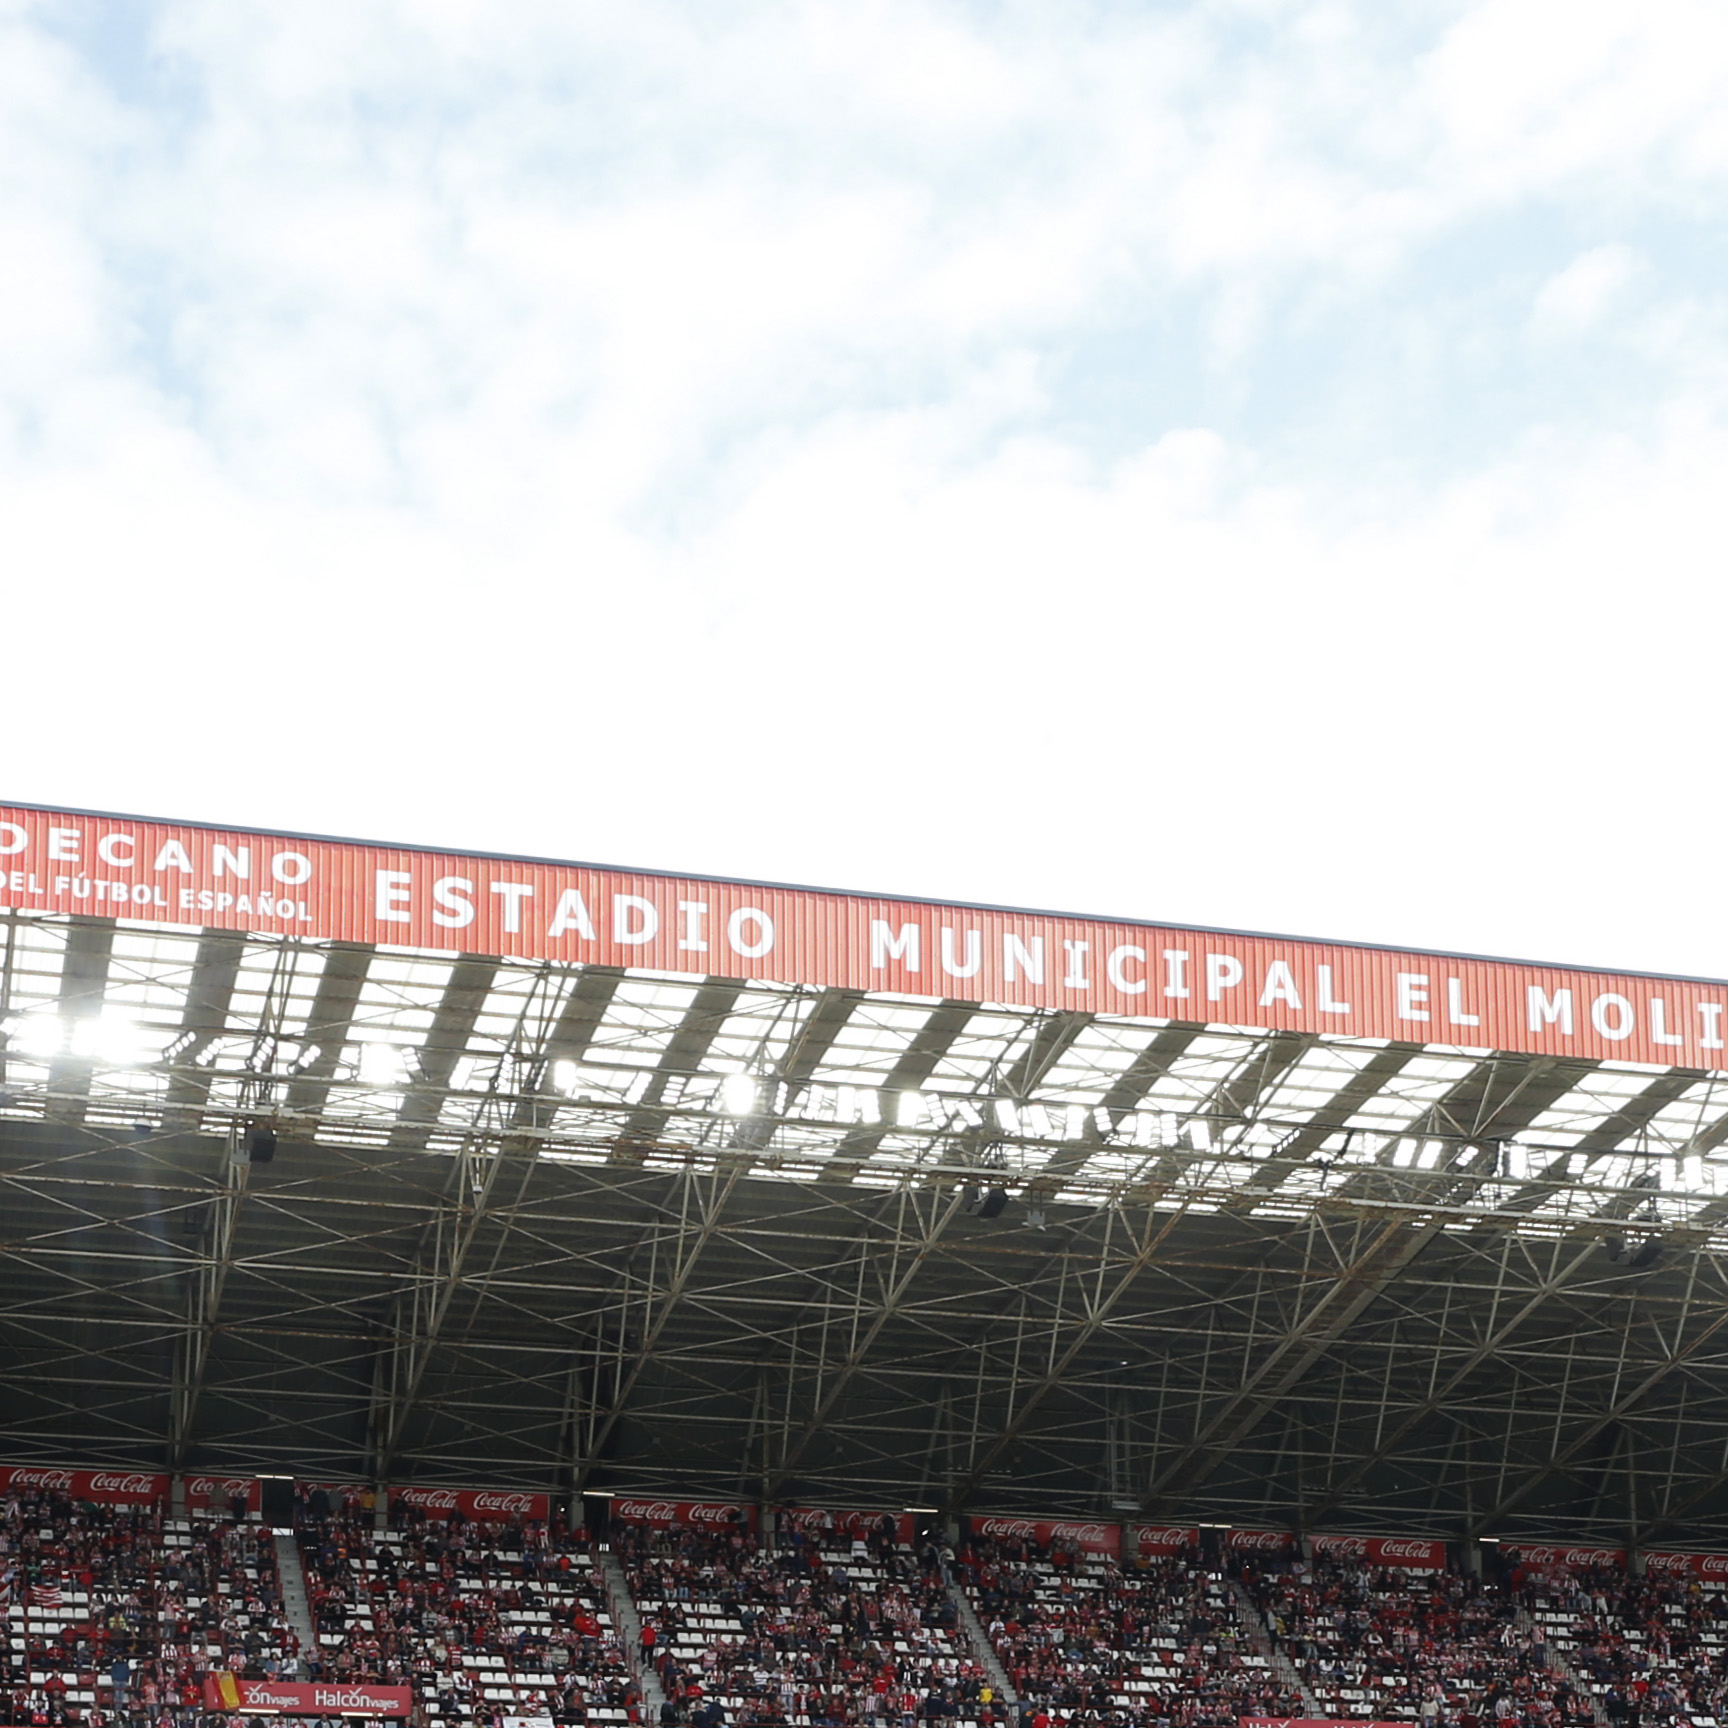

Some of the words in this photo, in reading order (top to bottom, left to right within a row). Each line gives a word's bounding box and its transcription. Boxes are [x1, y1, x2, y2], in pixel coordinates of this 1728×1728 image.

[55, 870, 168, 908] FÚTBOL
[180, 887, 313, 923] ESPAÑOL
[376, 869, 775, 958] ESTADIO
[872, 920, 1350, 1015] MUNICIPAL
[1399, 974, 1479, 1027] EL
[90, 1472, 155, 1493] Coca-Cola
